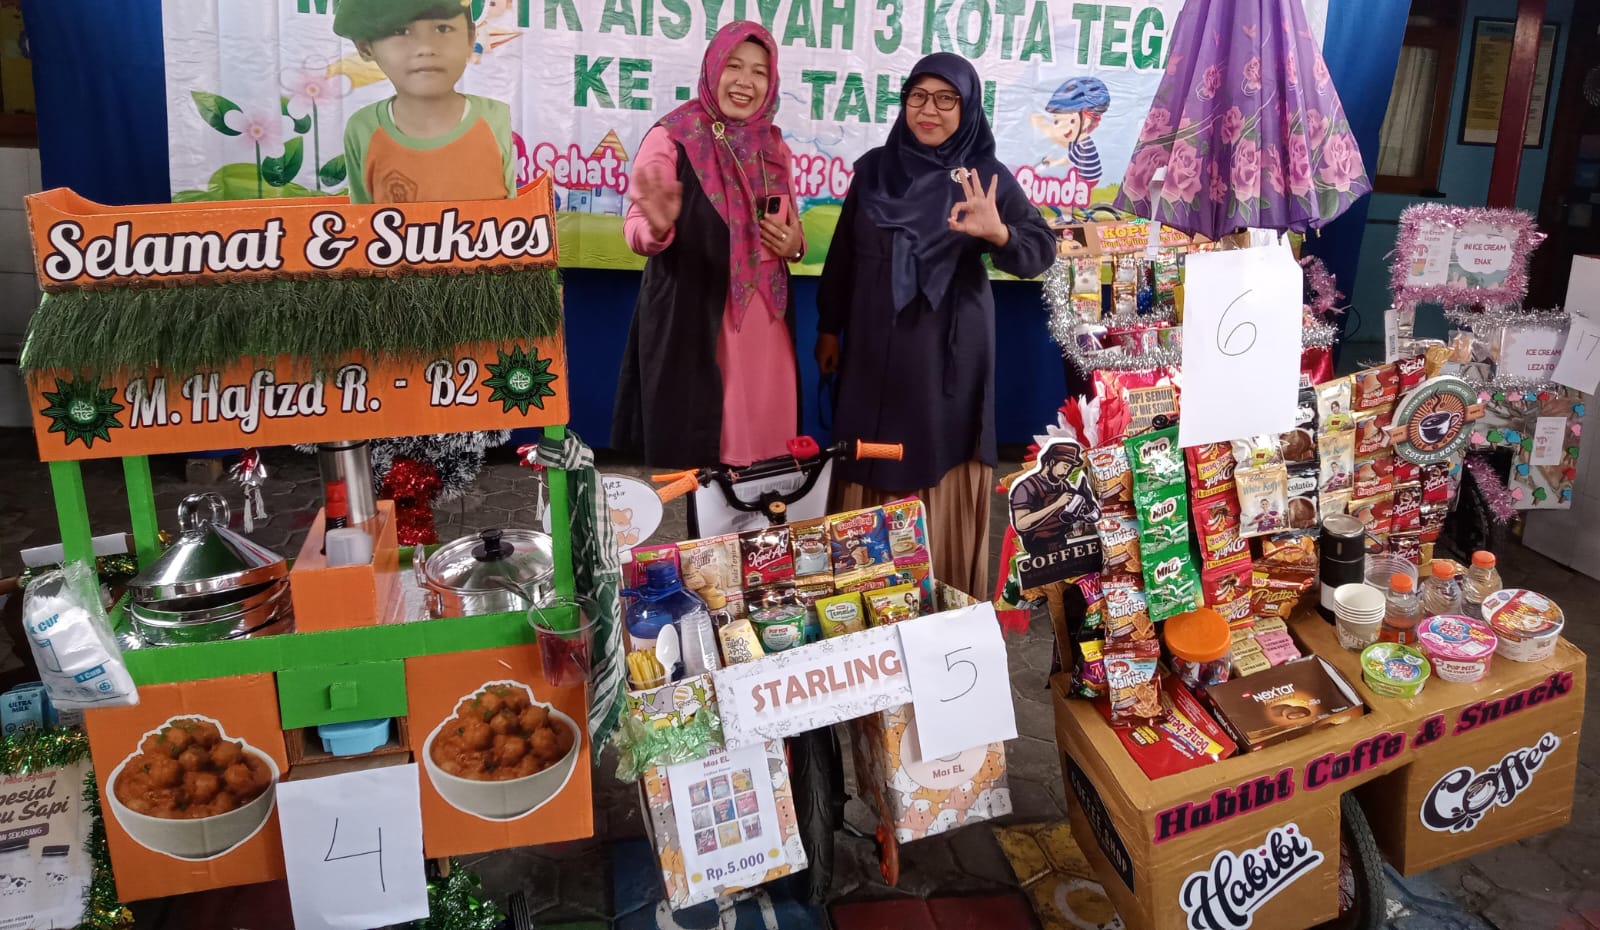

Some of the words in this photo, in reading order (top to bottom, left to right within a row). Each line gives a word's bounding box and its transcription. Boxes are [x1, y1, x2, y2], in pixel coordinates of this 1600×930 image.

[873, 0, 903, 54] 3
[921, 0, 1053, 63] KOTA
[573, 54, 653, 111] KE
[1019, 167, 1090, 206] Bunda
[45, 218, 284, 281] Selamat
[304, 211, 355, 268] &
[367, 209, 550, 279] Sukses
[1216, 289, 1258, 357] 6
[125, 373, 181, 429] M.
[336, 364, 381, 412] R.
[425, 358, 481, 407] B2
[1405, 448, 1436, 461] COFFEE
[1439, 432, 1466, 457] HOUSE
[1153, 503, 1175, 520] MILO
[1018, 541, 1099, 573] COFFEE
[1109, 600, 1147, 618] Malkist
[1252, 588, 1298, 605] Piattos
[37, 613, 60, 633] CUP
[751, 650, 903, 714] STARLING
[938, 646, 979, 704] 5
[1109, 671, 1148, 691] Malkist
[951, 764, 966, 776] EL
[1157, 766, 1293, 842] Habibi
[1306, 731, 1405, 790] Coffe
[1414, 717, 1445, 748] &
[1458, 673, 1571, 734] Snack
[0, 779, 56, 806] esial
[1420, 733, 1556, 831] Coffee
[19, 796, 71, 823] Sapi
[324, 816, 387, 893] 4
[706, 852, 765, 881] Rp.5.000
[1184, 826, 1310, 930] Habibi
